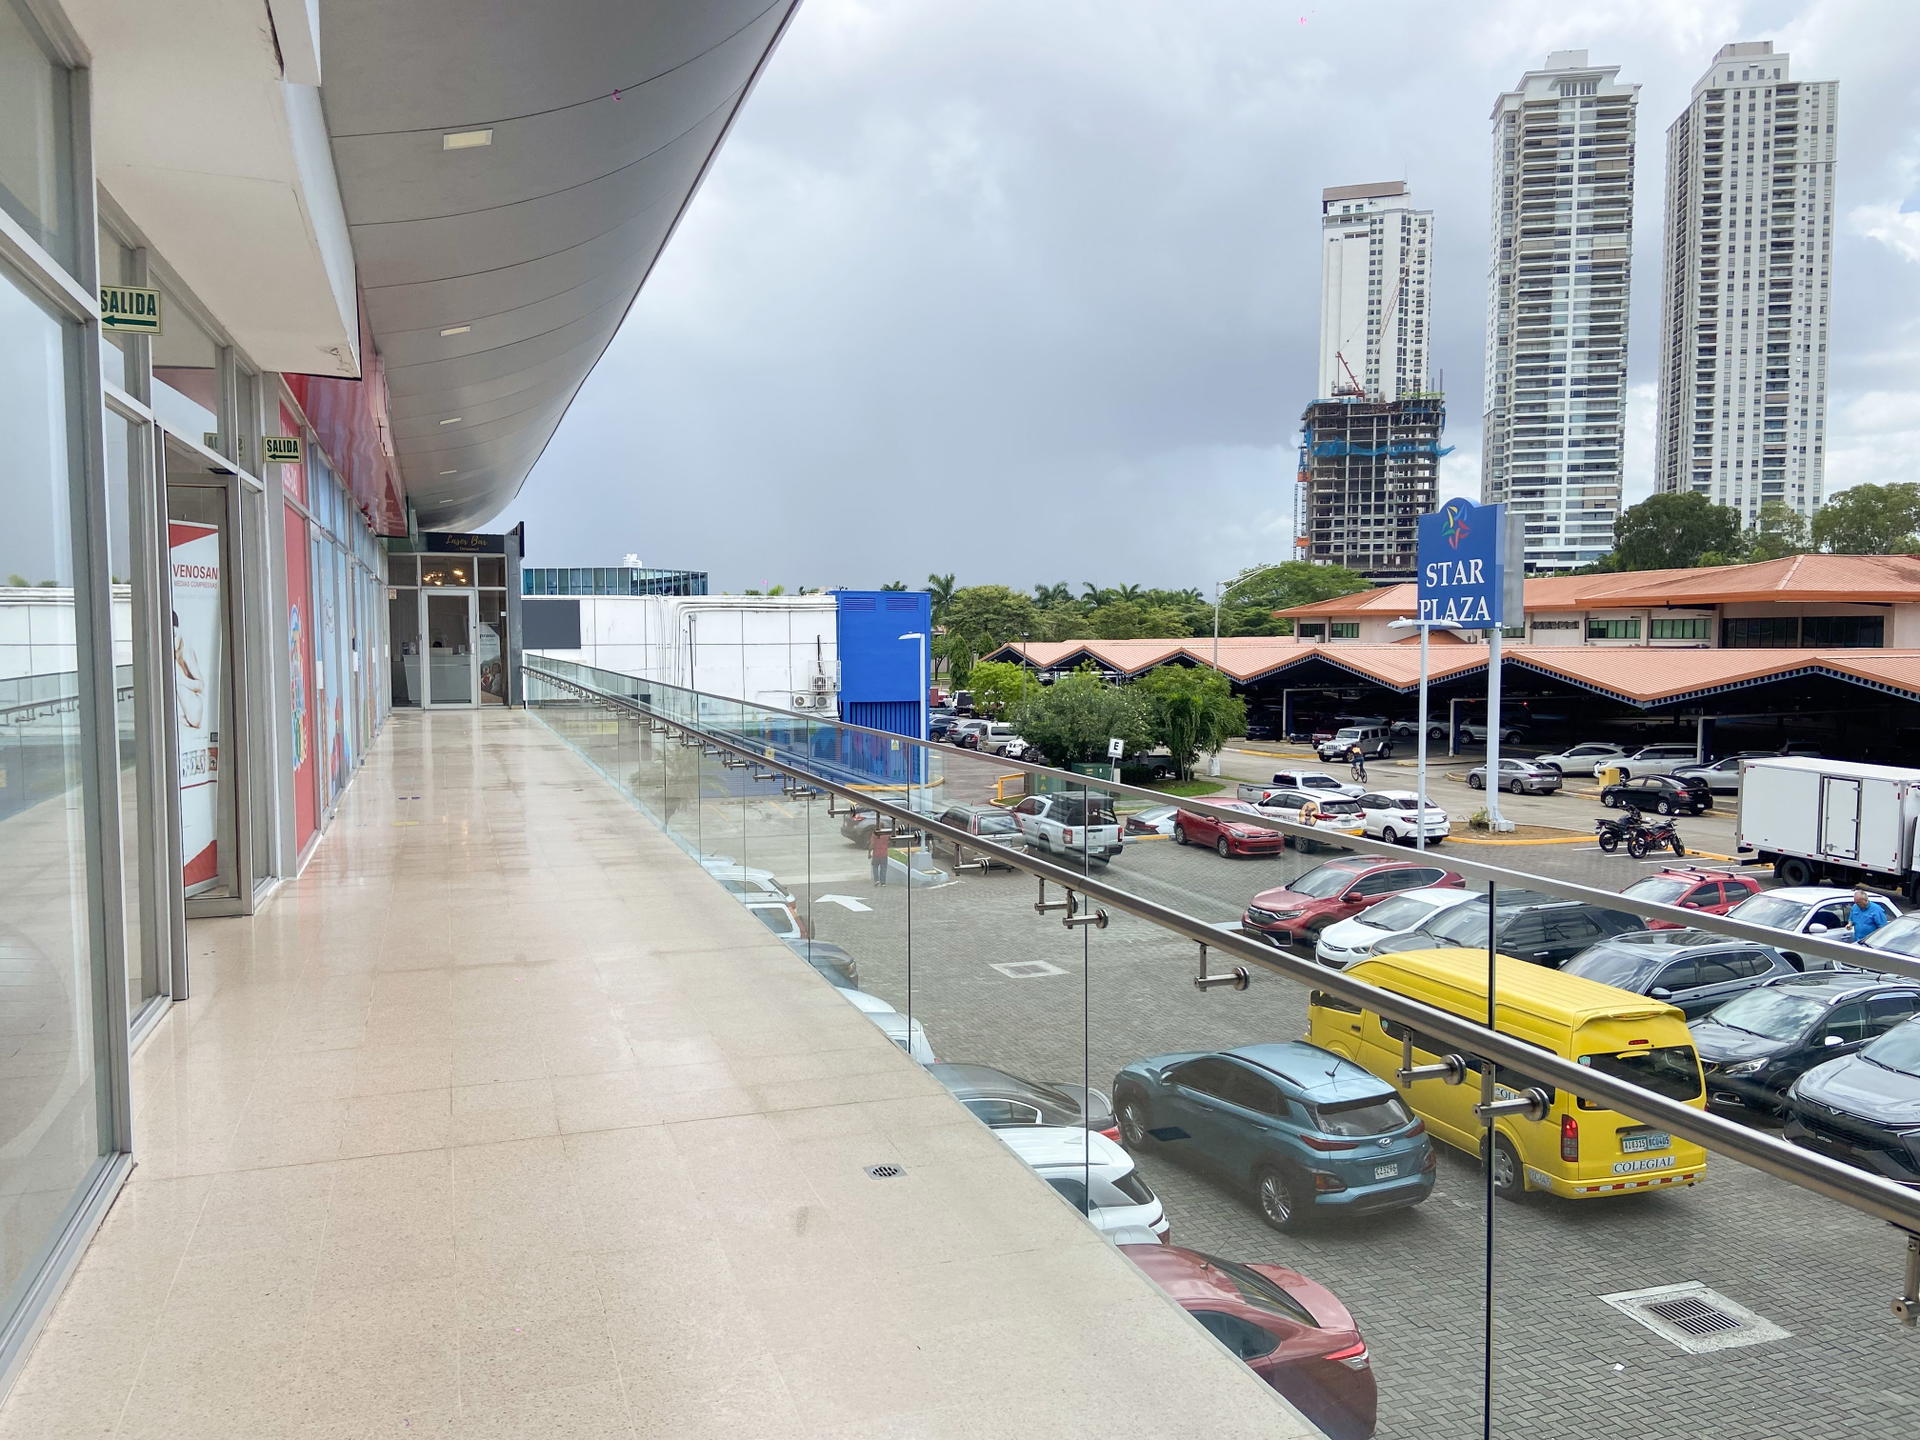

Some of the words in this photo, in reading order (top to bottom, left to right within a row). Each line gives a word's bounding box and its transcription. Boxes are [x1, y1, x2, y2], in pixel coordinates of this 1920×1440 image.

[101, 289, 157, 316] SALIDA
[267, 439, 299, 453] SALIDA
[172, 563, 218, 580] VENOSAN
[1426, 558, 1485, 588] STAR
[1419, 596, 1491, 622] PLAZA
[1113, 741, 1120, 751] E
[1614, 1156, 1673, 1174] COLEGIAL
